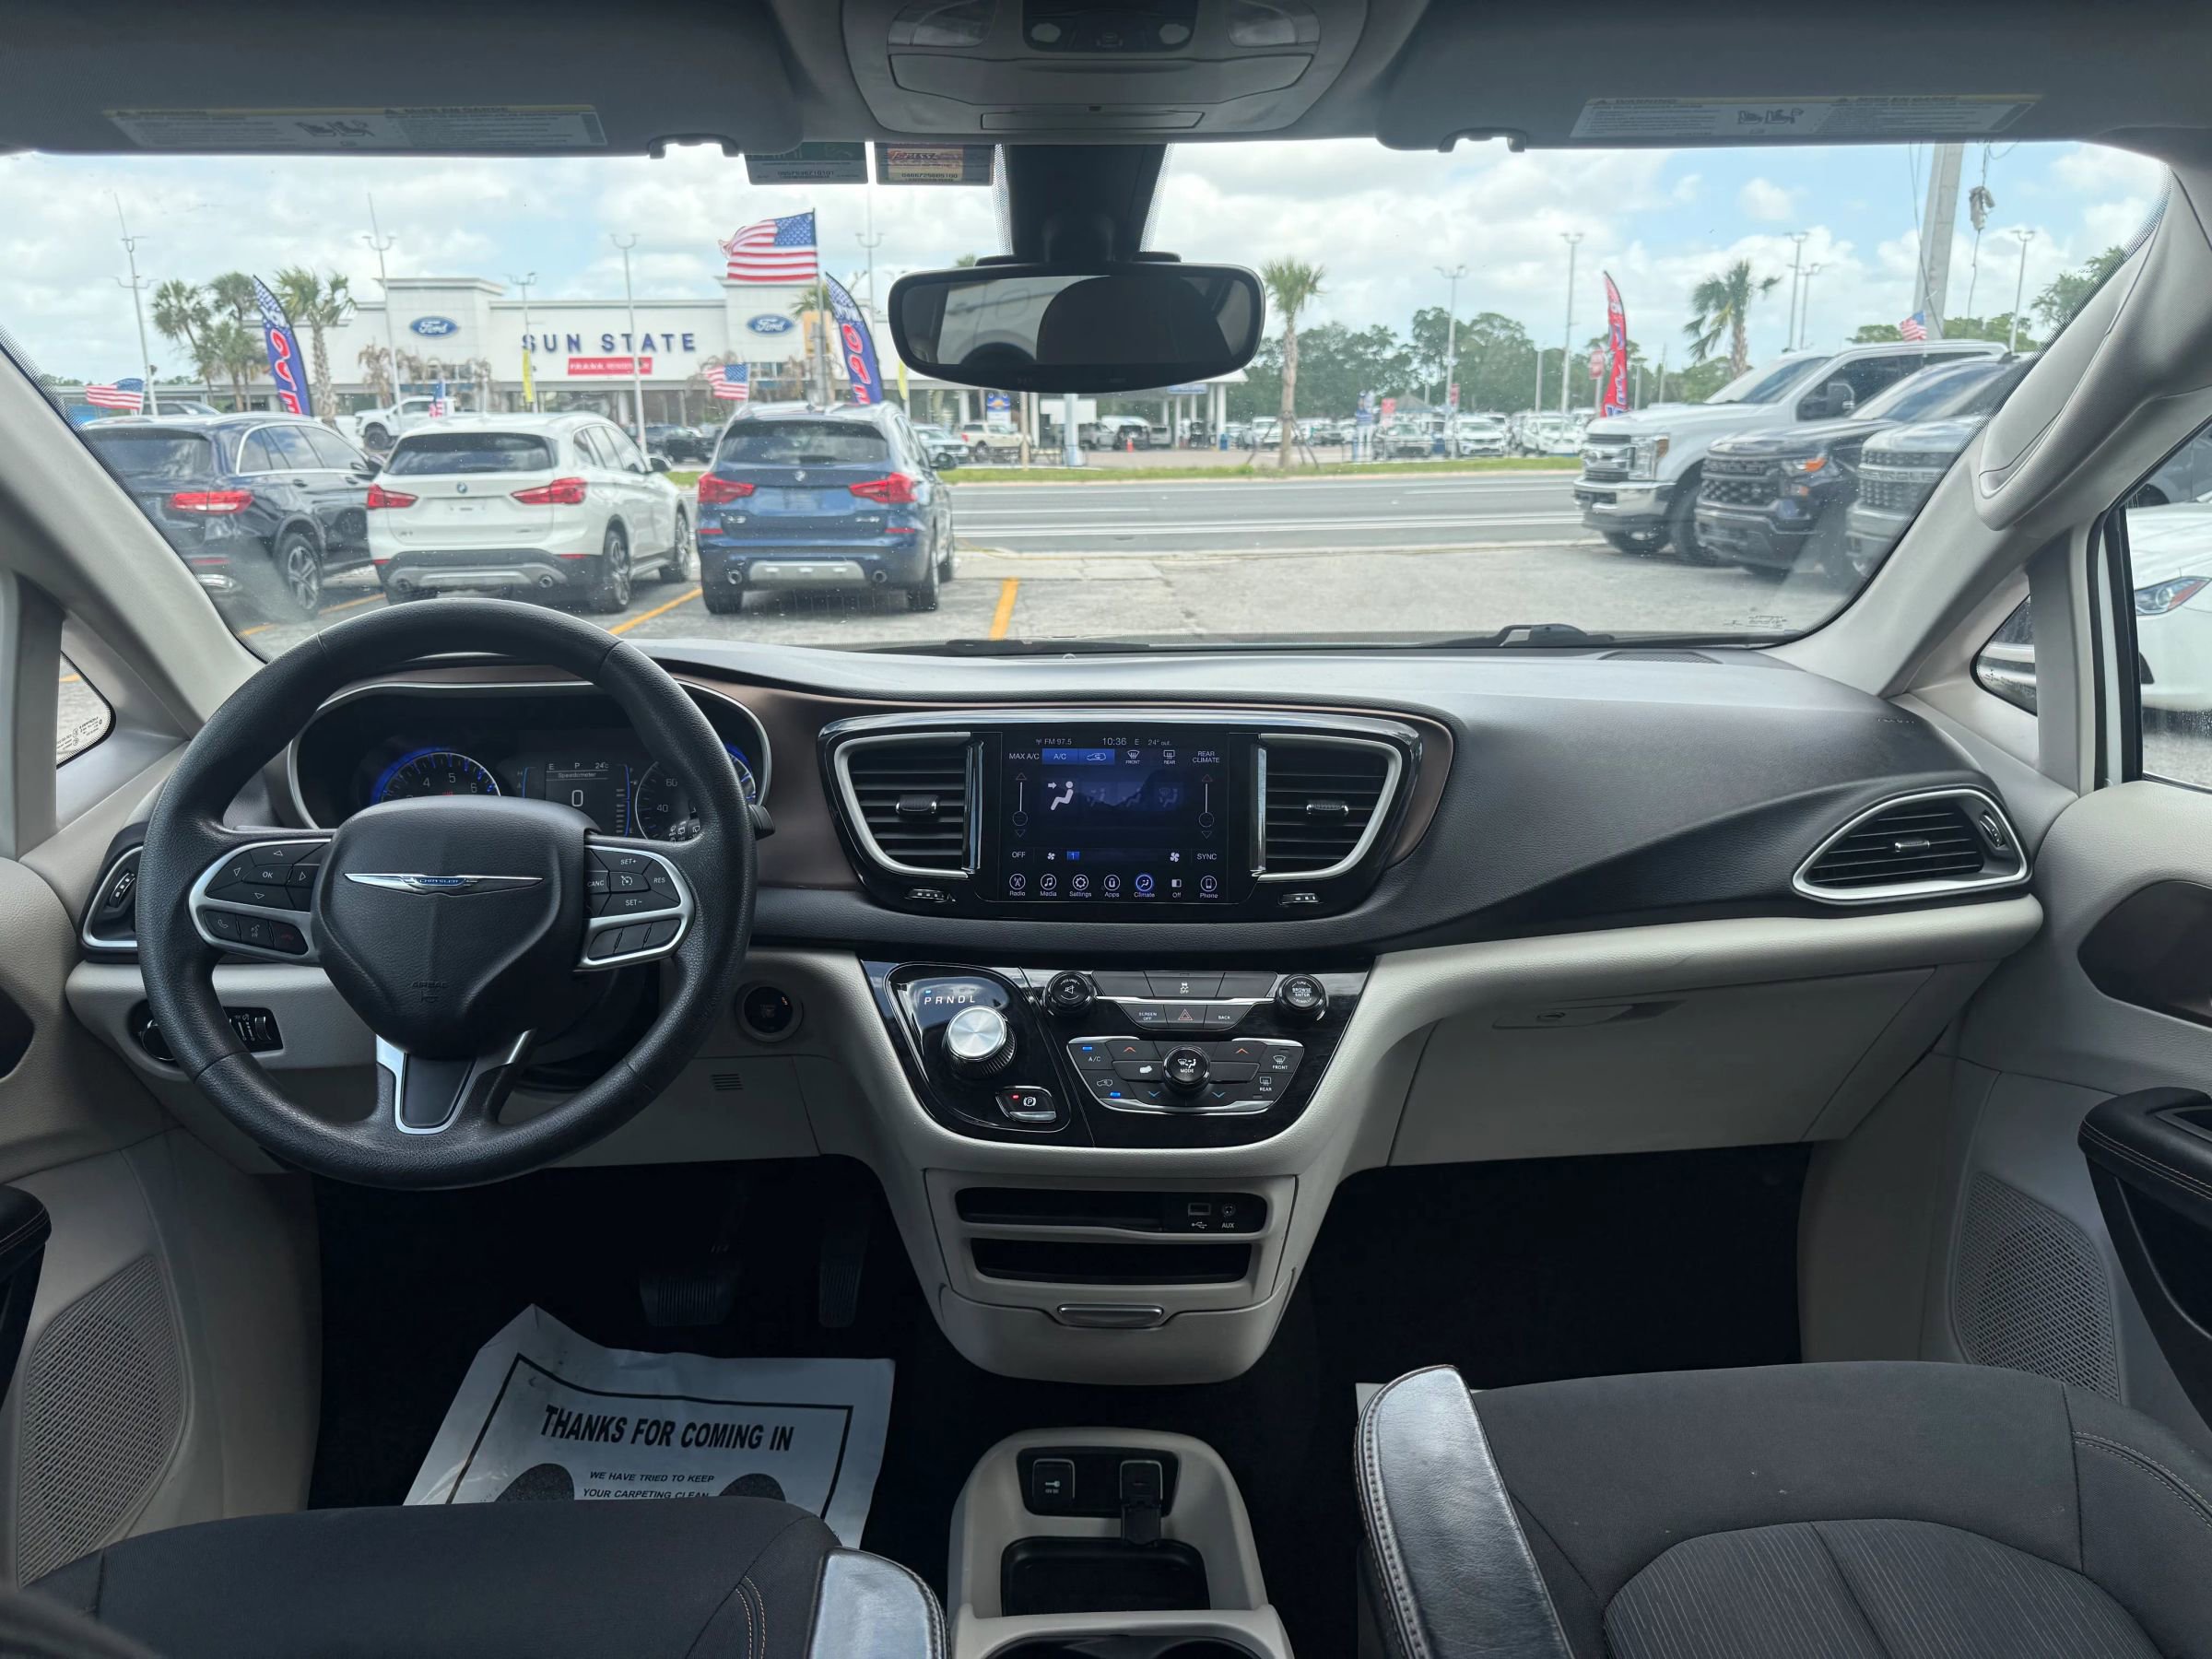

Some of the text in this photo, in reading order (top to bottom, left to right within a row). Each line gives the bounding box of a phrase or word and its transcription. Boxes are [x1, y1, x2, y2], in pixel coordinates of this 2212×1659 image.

[755, 317, 785, 332] Ford
[522, 333, 696, 353] SUN STATE
[1102, 737, 1127, 746] 10:36
[422, 777, 431, 788] 4
[448, 772, 456, 783] 5
[665, 778, 678, 787] 60
[470, 782, 477, 794] 6
[571, 789, 584, 807] 0
[656, 804, 669, 812] 40
[540, 1404, 795, 1452] THANKS FOR COMING IN
[589, 1470, 715, 1483] WE HAVE TRIED TO KEEP
[582, 1488, 612, 1499] YOUR
[614, 1489, 674, 1500] CARPETING
